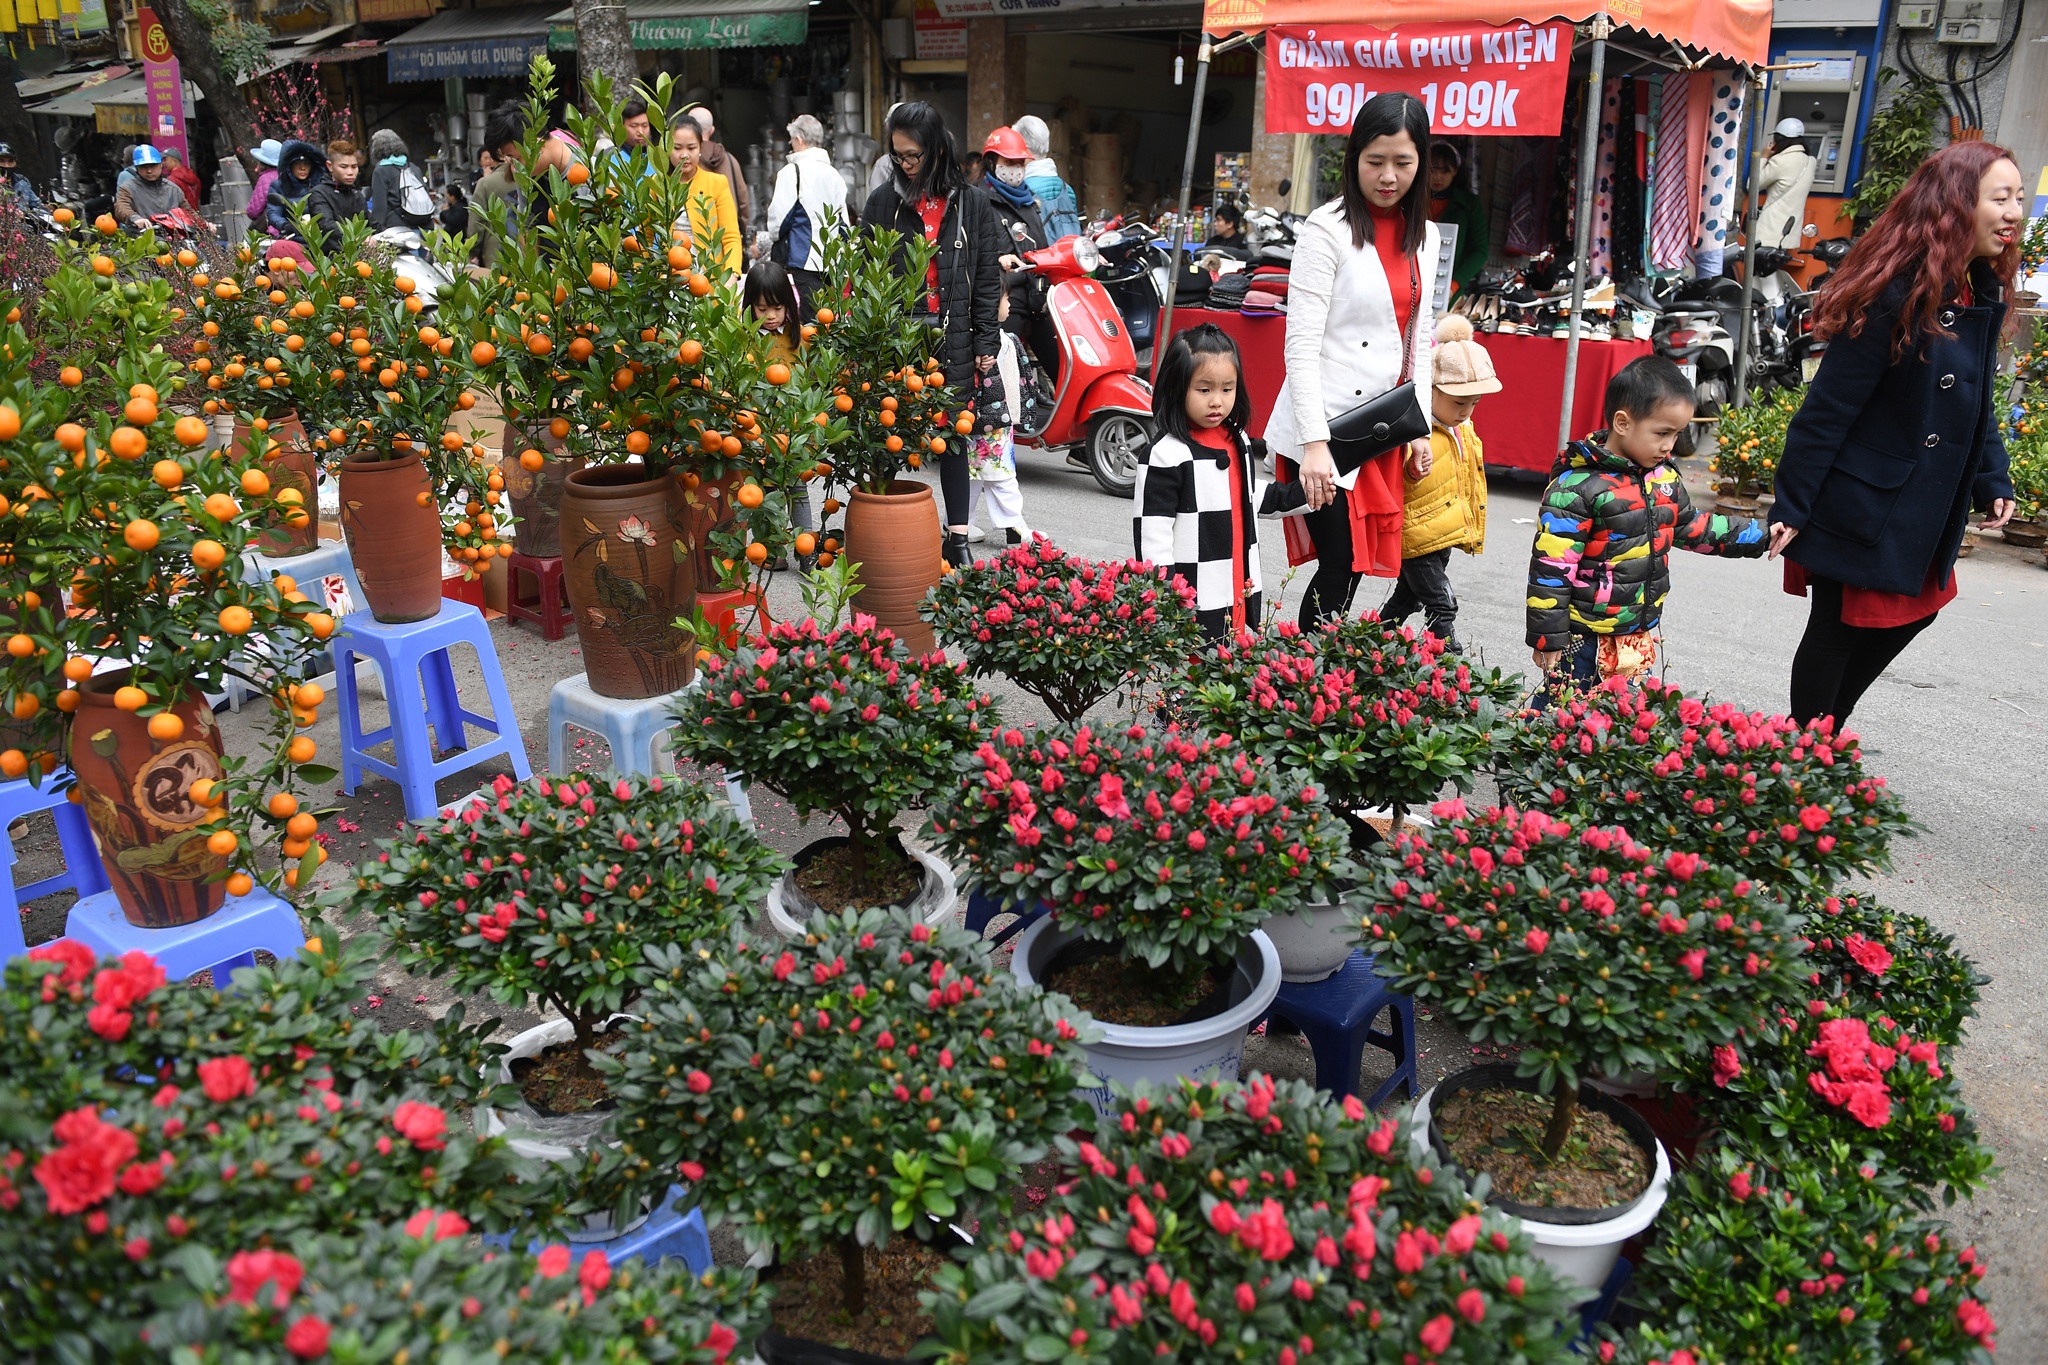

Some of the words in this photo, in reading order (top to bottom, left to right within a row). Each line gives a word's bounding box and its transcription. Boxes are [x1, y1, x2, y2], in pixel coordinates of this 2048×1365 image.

[704, 17, 750, 40] Lan
[1236, 14, 1263, 25] XUAN
[471, 48, 489, 65] GIA
[493, 46, 523, 67] DỤNG
[1278, 29, 1350, 69] GIẢM
[1353, 32, 1404, 69] GIÁ
[1410, 37, 1471, 72] PHỤ
[1483, 23, 1557, 71] KIỆN
[1421, 80, 1520, 128] 199k
